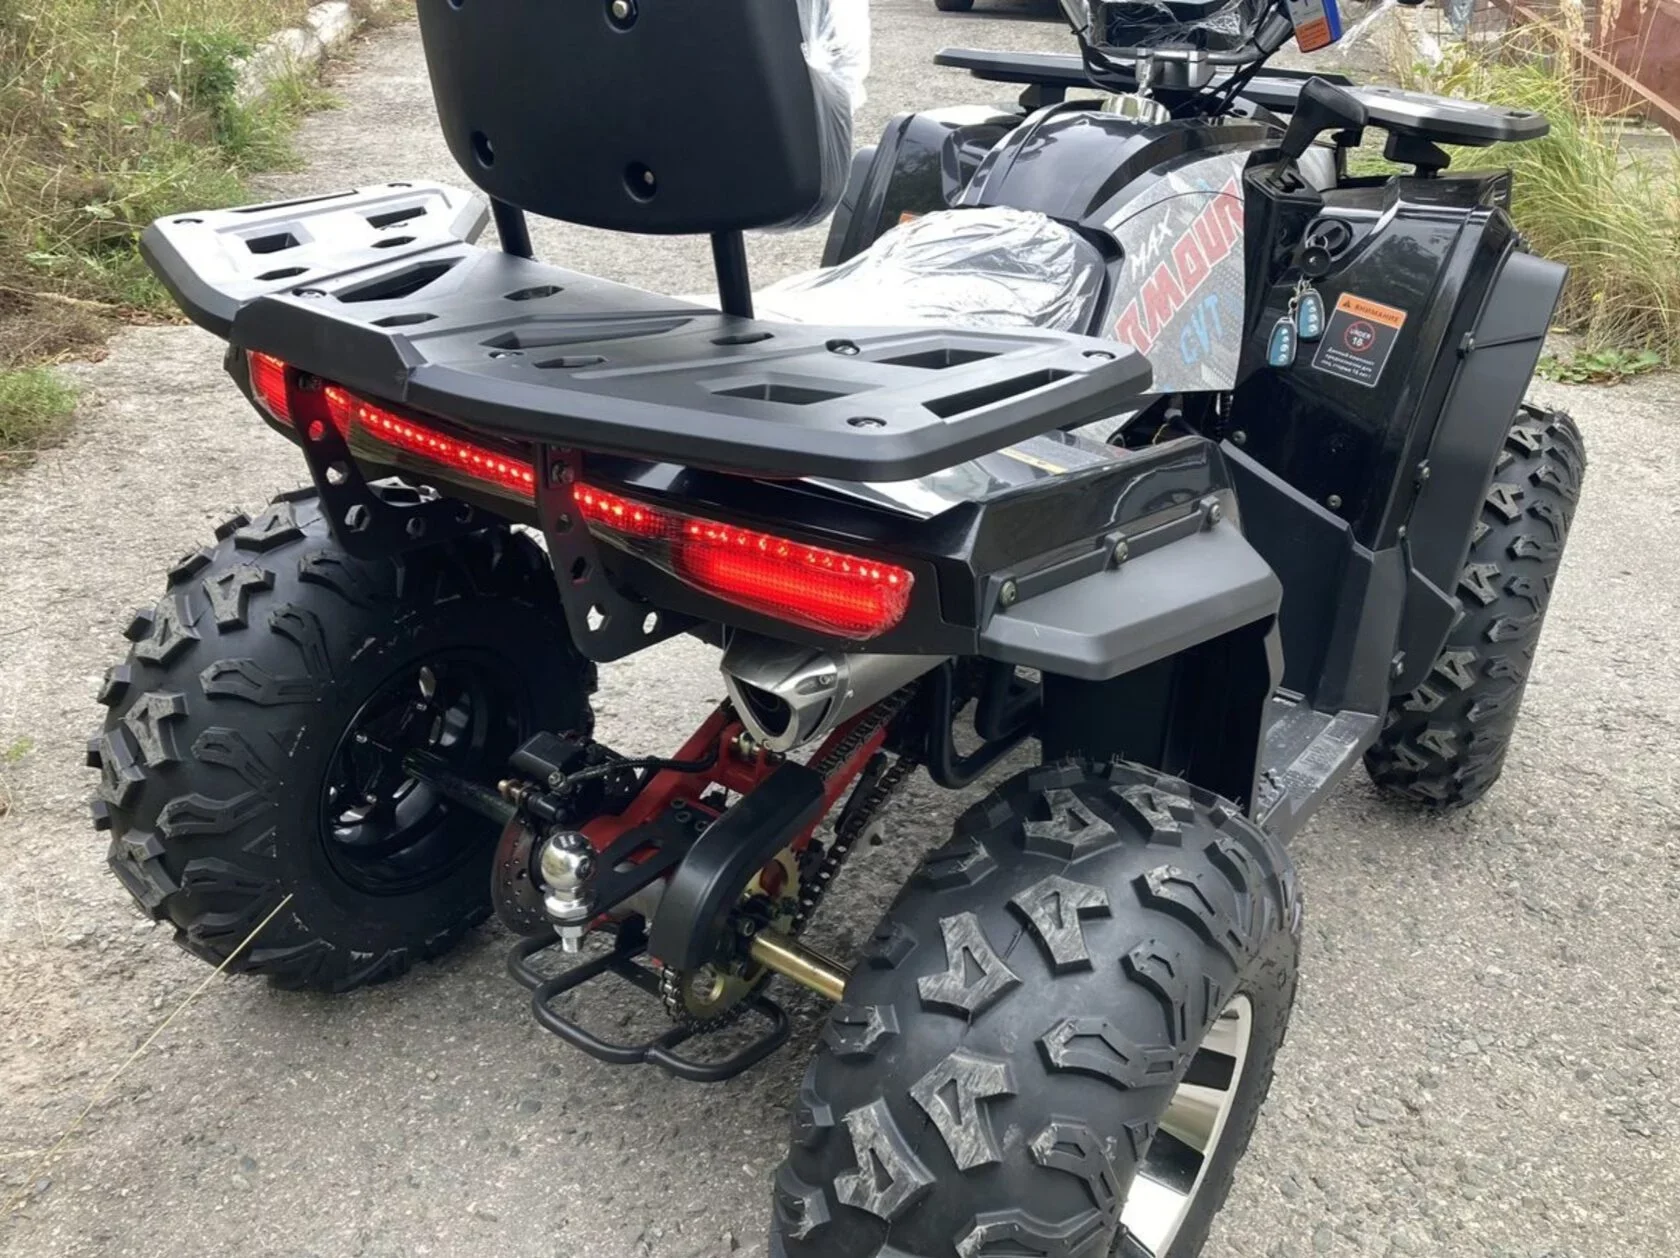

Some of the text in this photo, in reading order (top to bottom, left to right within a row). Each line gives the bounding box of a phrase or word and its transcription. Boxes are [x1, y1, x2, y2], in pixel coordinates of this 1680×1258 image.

[1107, 176, 1244, 356] RMOUR
[1130, 208, 1173, 281] MAX
[1181, 294, 1222, 365] CVT
[1350, 328, 1371, 340] UNDER
[1355, 304, 1399, 322] ВНИМАНИЕ
